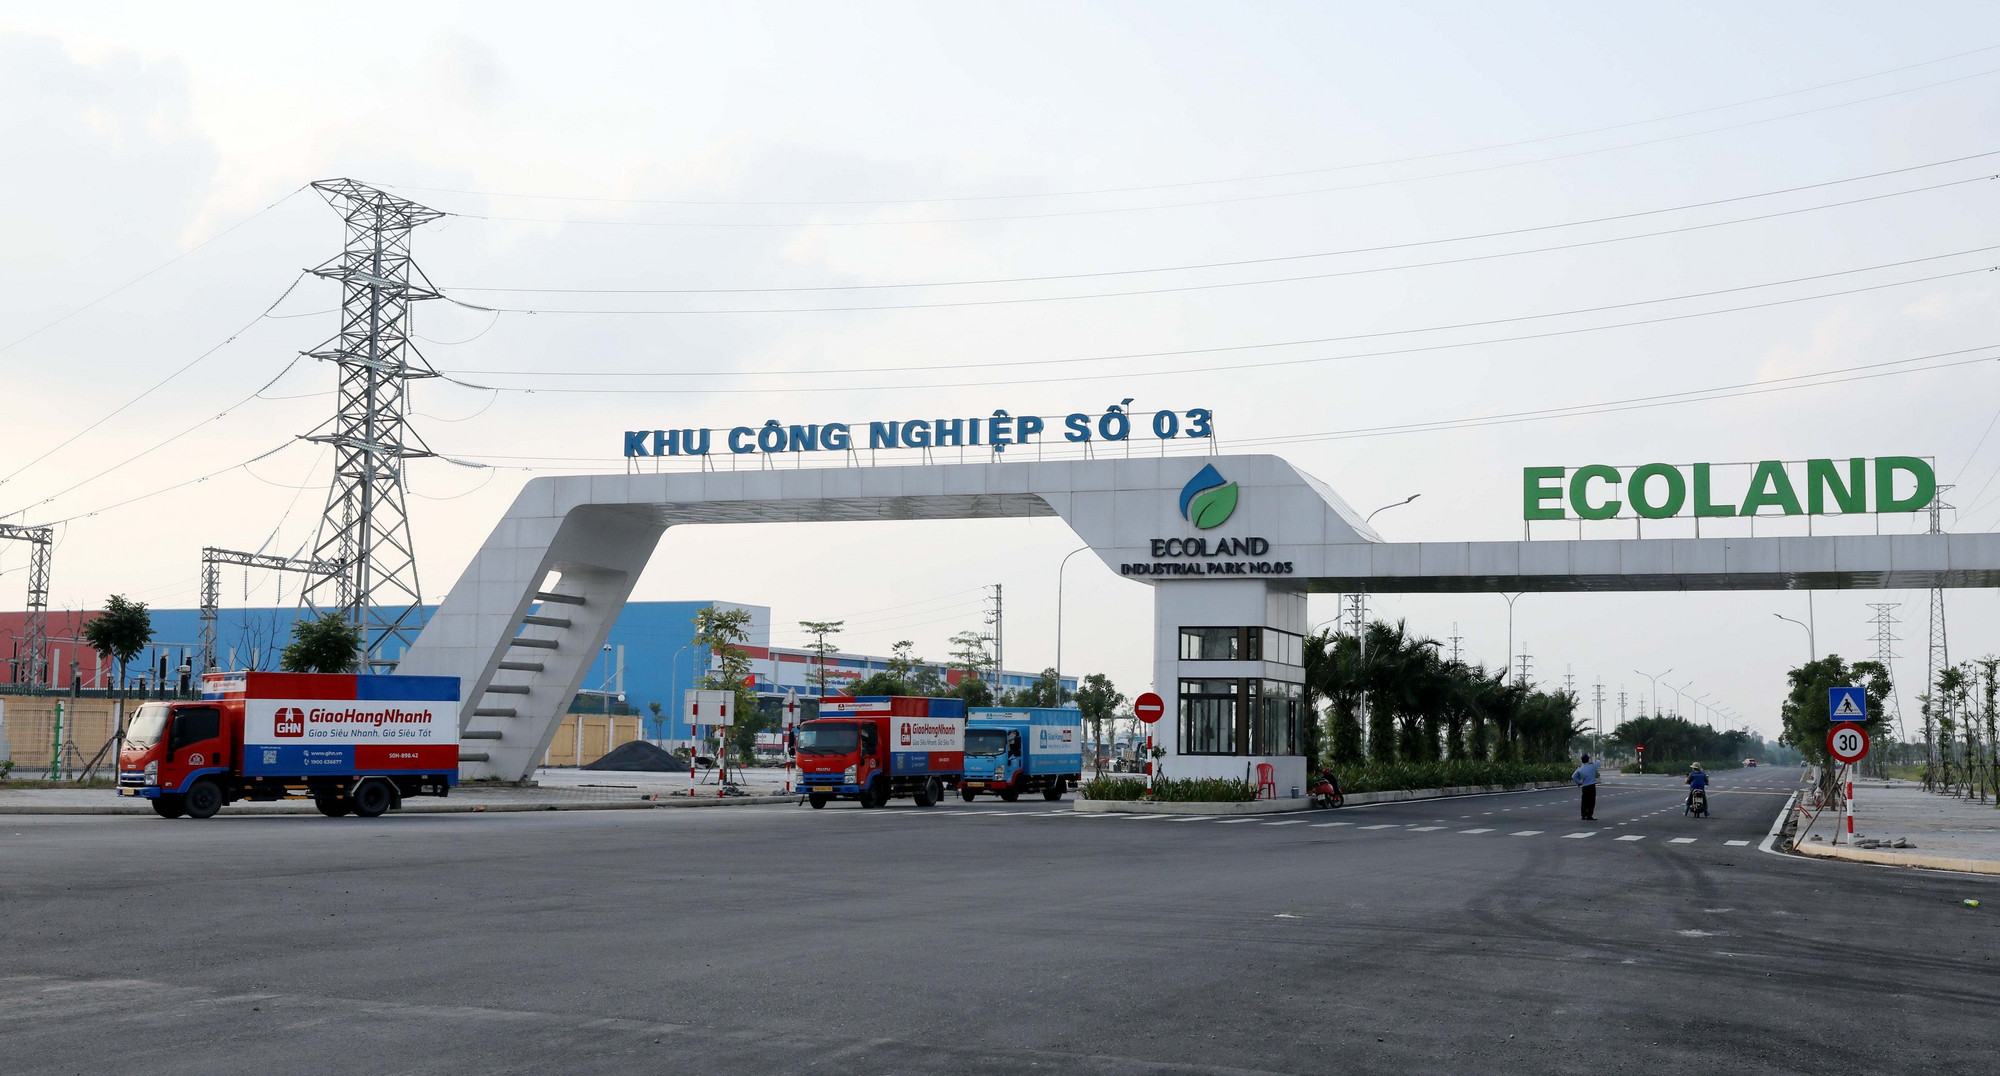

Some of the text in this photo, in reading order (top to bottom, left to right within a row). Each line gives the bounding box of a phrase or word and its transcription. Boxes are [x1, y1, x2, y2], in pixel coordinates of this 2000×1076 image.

[624, 398, 1213, 457] KHU CÔNG NGHIỆP SỐ 03
[1523, 456, 1936, 520] ECOLAND
[1150, 537, 1269, 558] ECOLAND
[1120, 562, 1205, 576] INDUSTRIAL
[1206, 562, 1246, 574] PARK
[309, 708, 432, 727] GiaoHangNhanh
[276, 722, 302, 734] GHN
[308, 729, 328, 738] Giao
[330, 729, 349, 738] Siêu
[398, 729, 416, 738] Siêu
[1839, 734, 1858, 751] 30
